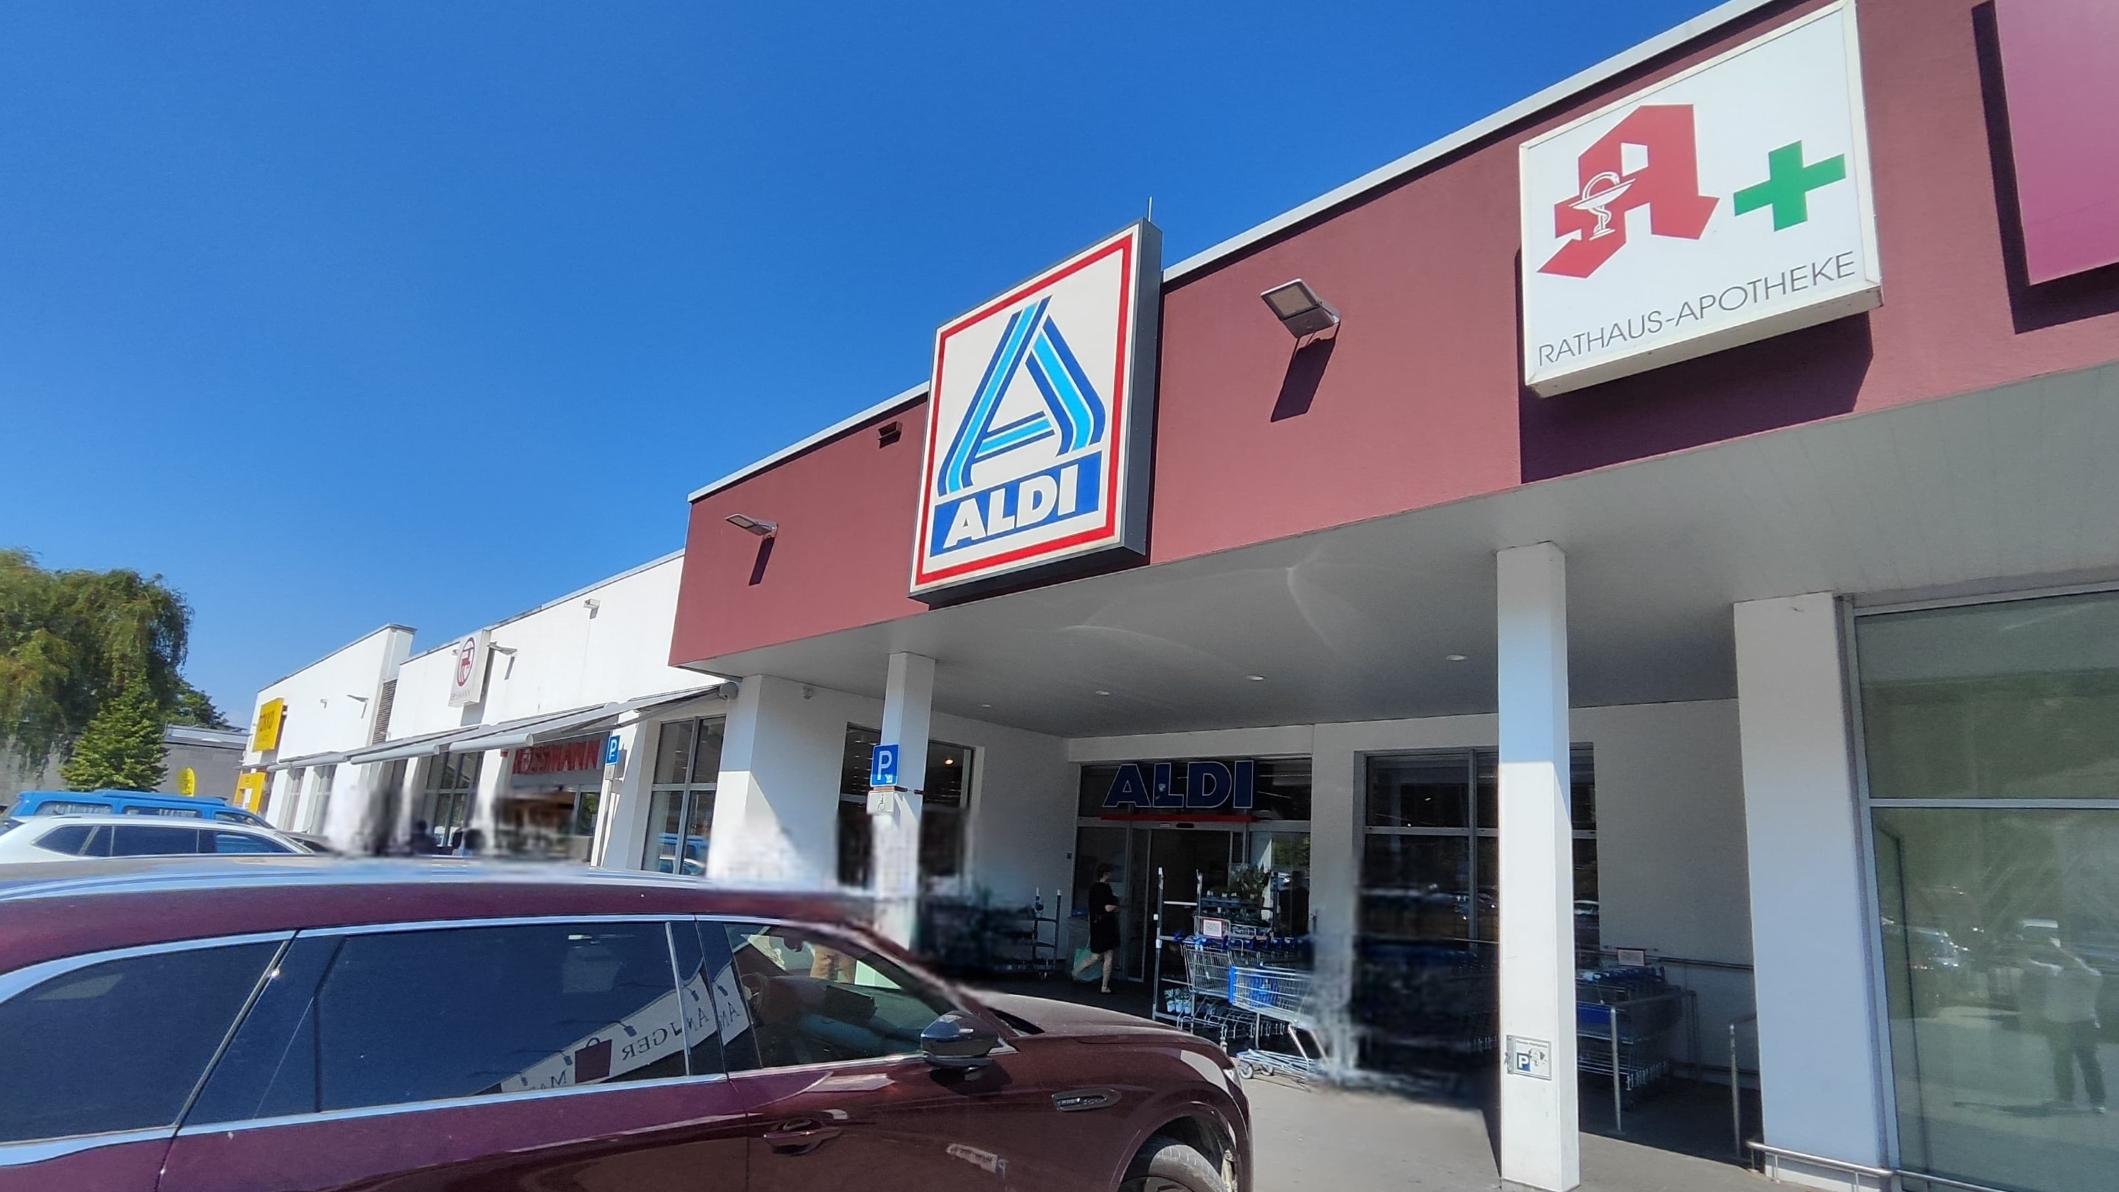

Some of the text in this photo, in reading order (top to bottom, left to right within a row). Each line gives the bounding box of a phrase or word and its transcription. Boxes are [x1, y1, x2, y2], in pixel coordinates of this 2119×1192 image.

[1538, 250, 1856, 367] RATHAUS-APOTHEKE
[943, 463, 1079, 549] ALDI
[877, 750, 892, 781] P
[1102, 759, 1254, 809] ALDI
[1518, 1054, 1530, 1069] P
